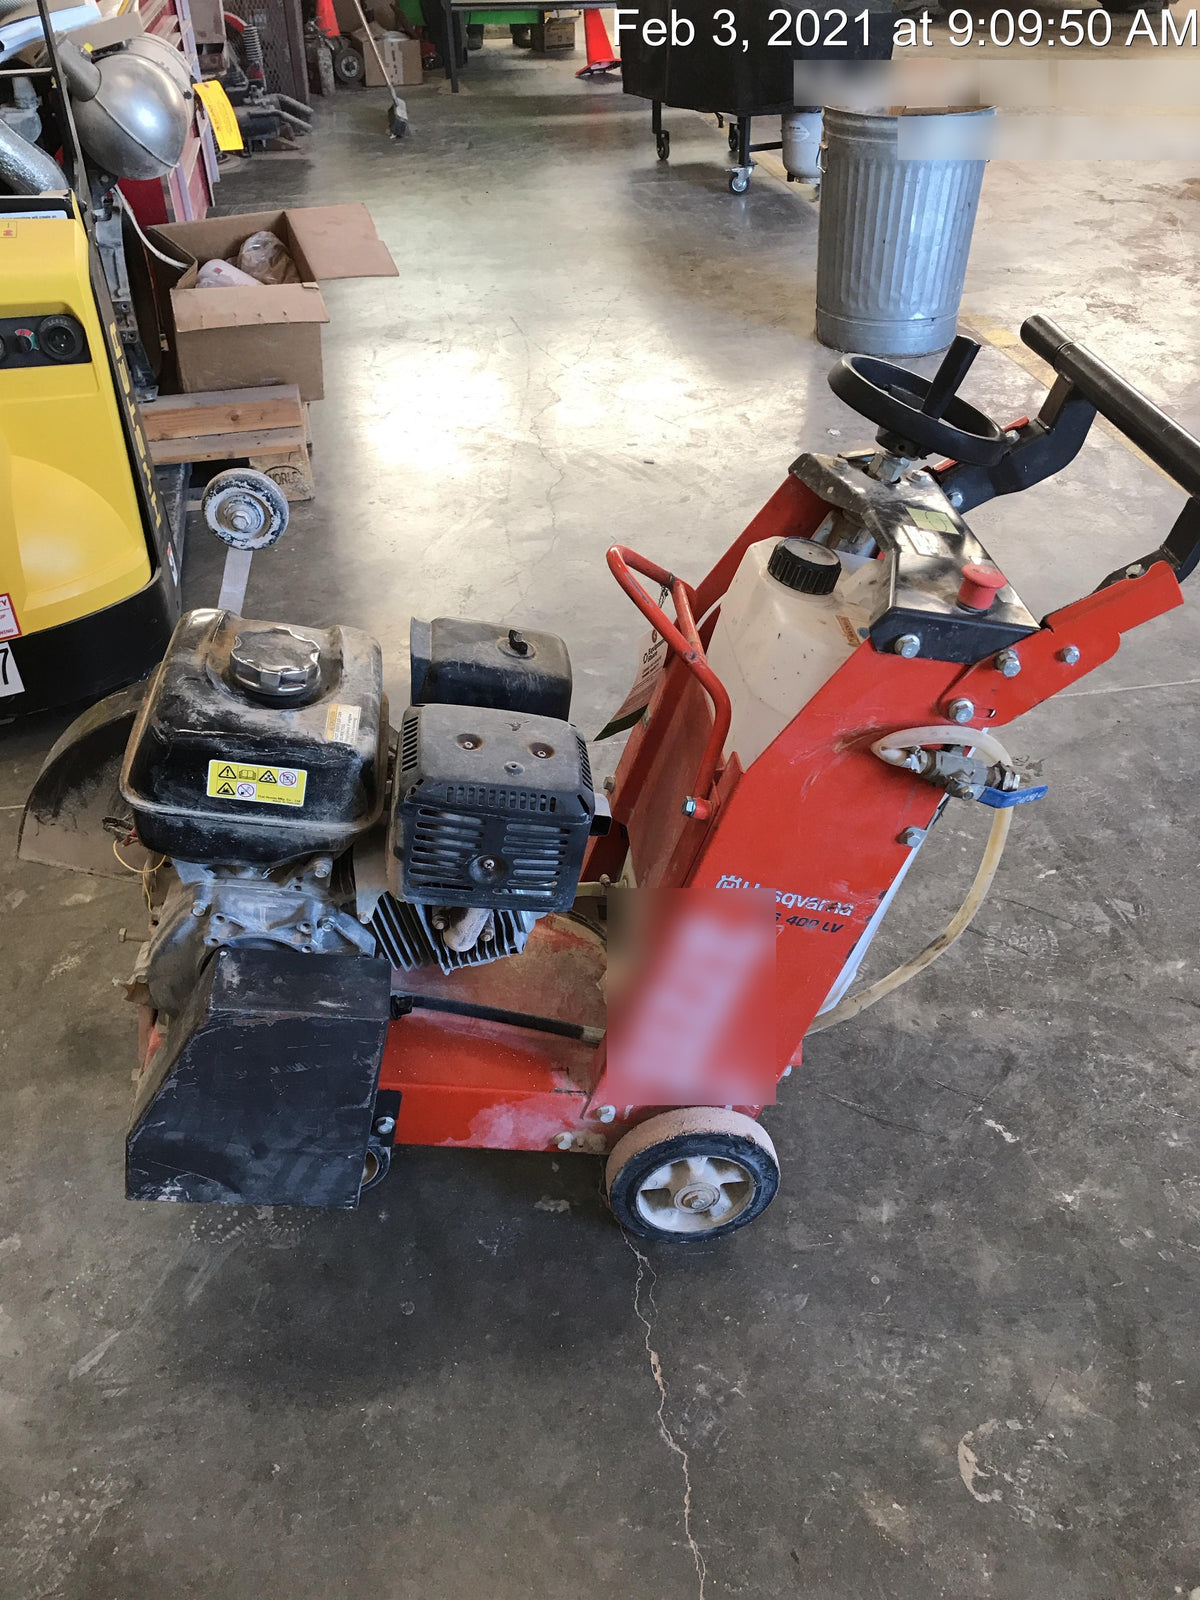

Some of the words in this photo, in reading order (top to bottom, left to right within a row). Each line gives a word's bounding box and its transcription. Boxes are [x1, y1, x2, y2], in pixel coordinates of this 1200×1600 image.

[109, 322, 162, 528] HYSTER
[785, 915, 820, 929] 400
[822, 921, 844, 933] LV
